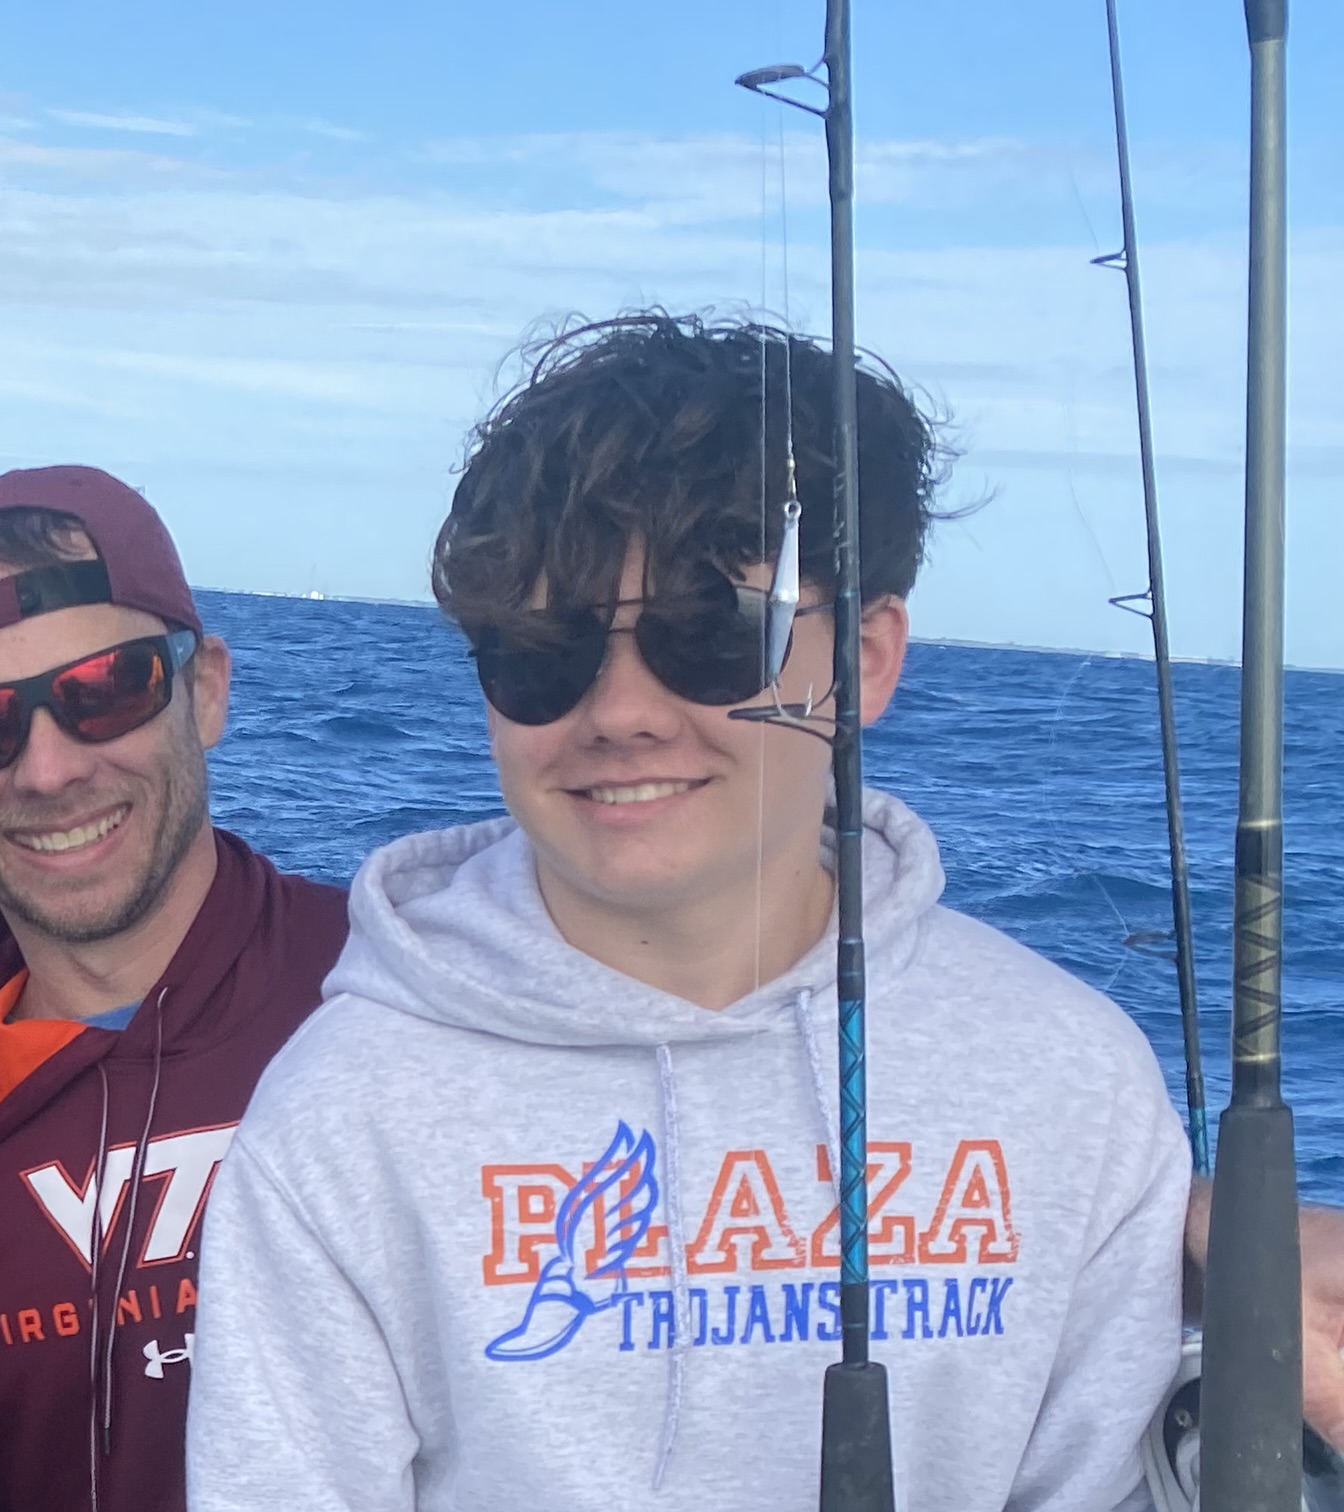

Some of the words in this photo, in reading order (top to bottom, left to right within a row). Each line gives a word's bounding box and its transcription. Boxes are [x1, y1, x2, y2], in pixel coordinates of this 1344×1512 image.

[18, 1119, 241, 1274] VT
[480, 1140, 1021, 1286] PLAZA
[868, 1278, 1014, 1341] TRACK
